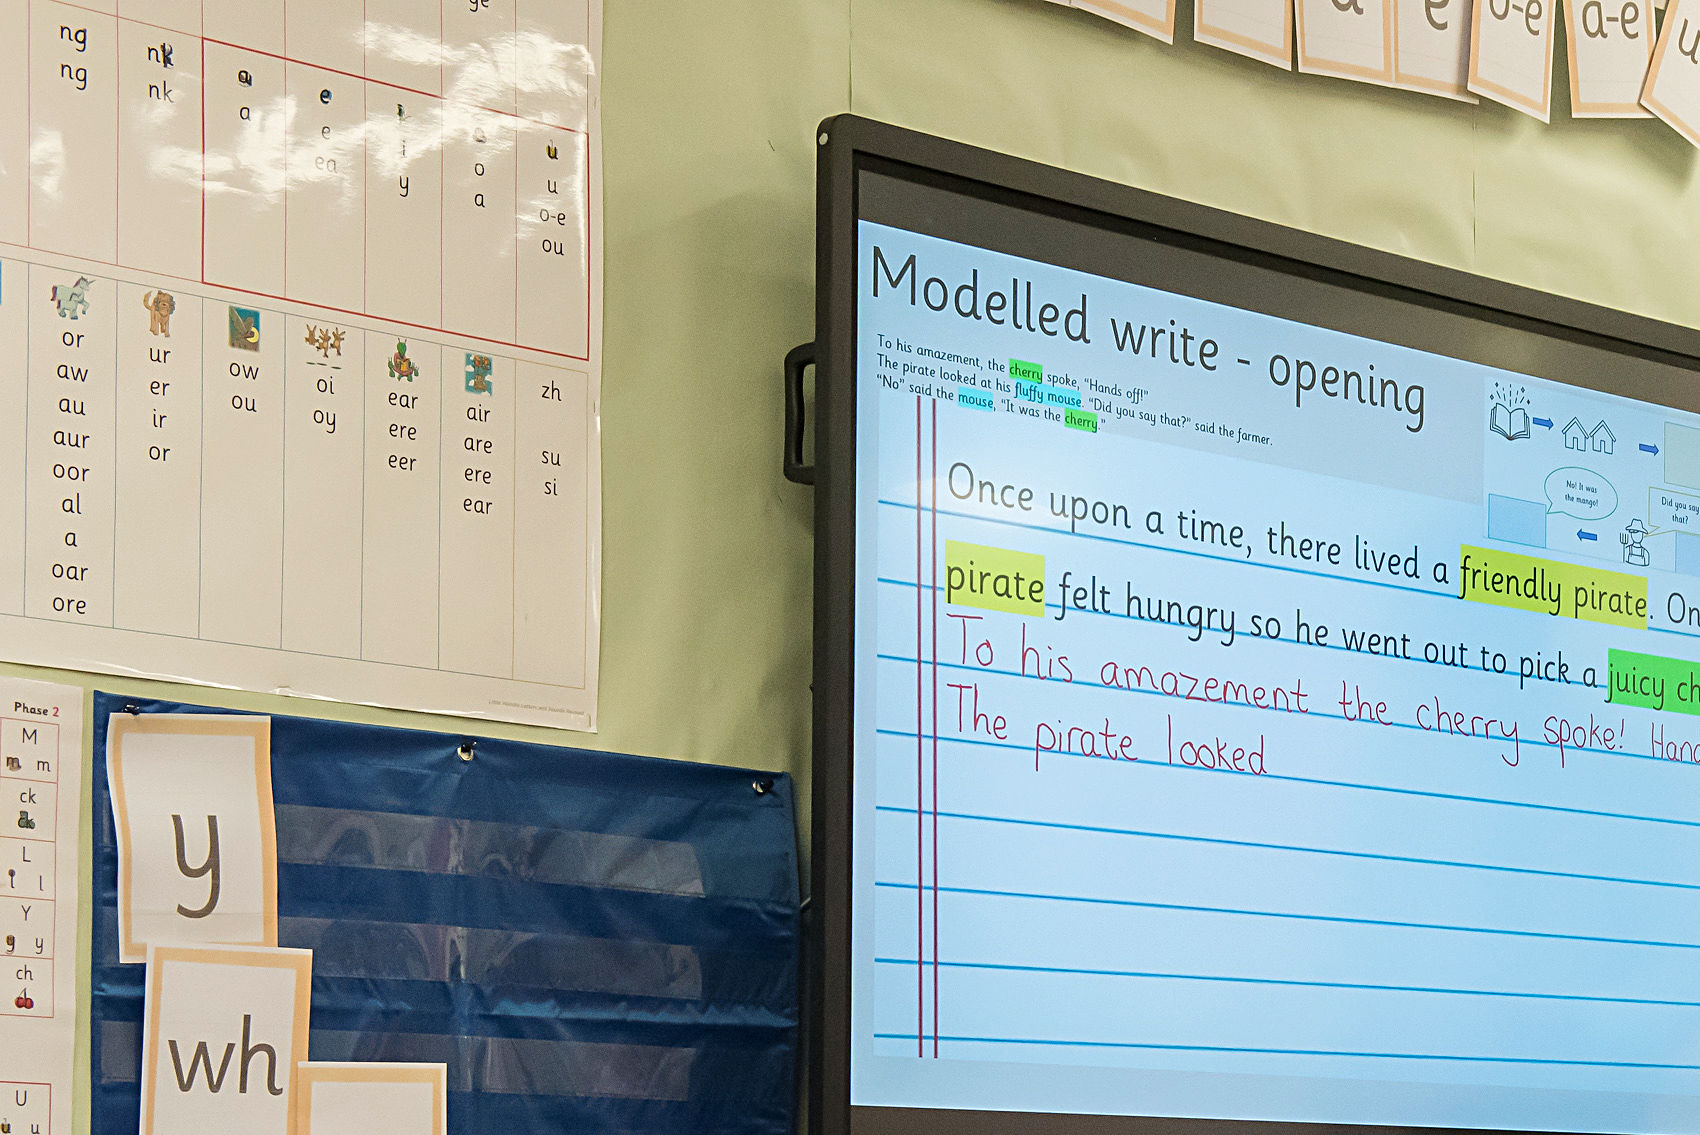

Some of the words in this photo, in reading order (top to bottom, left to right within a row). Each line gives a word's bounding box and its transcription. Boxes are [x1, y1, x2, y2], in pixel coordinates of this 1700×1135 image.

[1582, 1, 1639, 39] a-e
[59, 24, 88, 52] ng
[149, 81, 173, 102] nk
[539, 208, 566, 226] o-e
[871, 245, 1091, 345] Modelled
[1110, 315, 1219, 372] write
[1269, 349, 1425, 433] opening
[229, 363, 259, 380] ow
[877, 334, 892, 348] To
[897, 338, 912, 353] his
[917, 346, 983, 371] amazement,
[988, 358, 1005, 372] the
[1009, 364, 1043, 384] cherry
[1047, 370, 1080, 391] spoke,
[387, 391, 417, 410] ear
[541, 381, 562, 402] zh
[877, 353, 898, 370] The
[903, 362, 936, 377] pirate
[940, 366, 975, 386] looked
[981, 378, 992, 389] at
[996, 379, 1011, 393] his
[1014, 382, 1043, 403] fluffy
[1048, 391, 1084, 408] mouse.
[1116, 405, 1135, 420] you
[1139, 411, 1156, 426] say
[1195, 421, 1215, 434] said
[1219, 424, 1235, 438] the
[1236, 428, 1273, 446] farmer.
[909, 383, 932, 396] said
[936, 388, 954, 400] the
[958, 394, 996, 412] mouse,
[1018, 406, 1040, 417] was
[1044, 408, 1061, 422] the
[313, 410, 336, 433] oy
[466, 403, 490, 423] air
[53, 430, 89, 449] aur
[52, 463, 89, 483] oor
[948, 462, 1034, 512] Once
[1049, 486, 1131, 534] upon
[1145, 510, 1165, 534] a
[1177, 509, 1253, 558] time,
[1267, 523, 1342, 567] there
[1354, 533, 1420, 581] lived
[1433, 560, 1450, 584] a
[1458, 555, 1562, 616] friendly
[1574, 580, 1654, 620] pirate.
[52, 563, 88, 581] oar
[946, 562, 1045, 605] pirate
[1056, 572, 1111, 622] felt
[1125, 580, 1238, 647] hungry
[1250, 611, 1281, 640] so
[1296, 606, 1329, 648] he
[1343, 622, 1410, 661] went
[1423, 632, 1469, 670] out
[1480, 642, 1506, 674] to
[1518, 645, 1572, 690] pick
[1583, 662, 1598, 688] a
[1604, 662, 1666, 709] juicy
[947, 613, 996, 670] To
[1021, 623, 1074, 682] his
[1101, 656, 1309, 713] amazement
[1340, 678, 1394, 725] the
[1415, 697, 1520, 768] cherry
[1544, 713, 1627, 770] spoke!
[14, 701, 48, 717] Phase
[947, 681, 1008, 741] The
[1034, 718, 1138, 772] pirate
[1167, 715, 1267, 776] looked
[173, 814, 221, 918] y
[168, 1014, 283, 1096] wh
